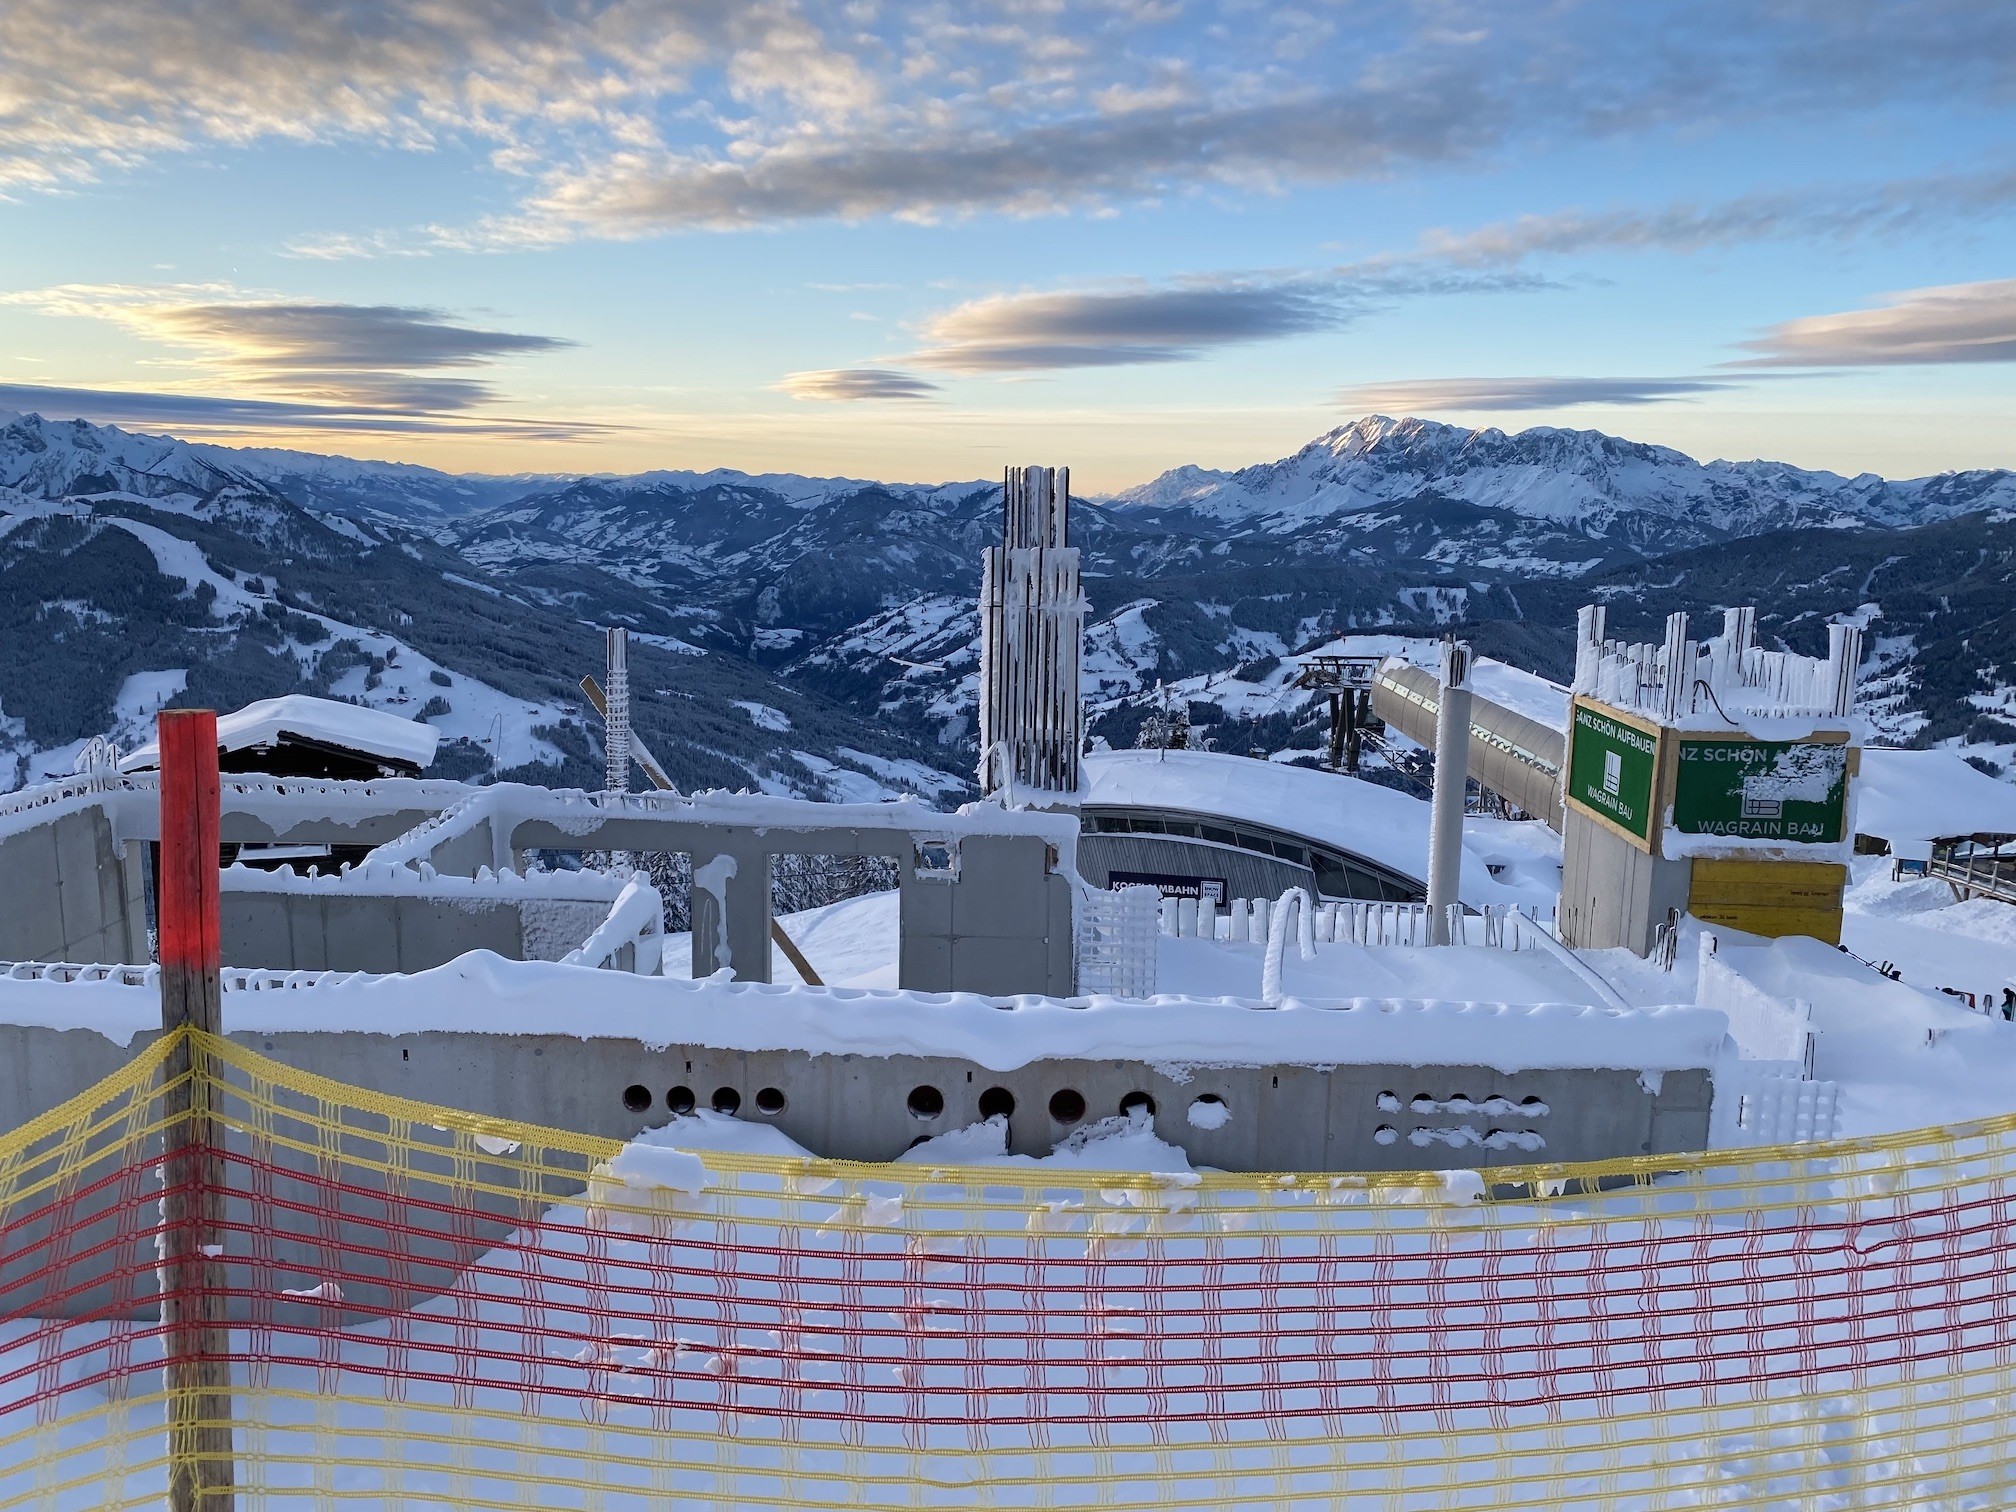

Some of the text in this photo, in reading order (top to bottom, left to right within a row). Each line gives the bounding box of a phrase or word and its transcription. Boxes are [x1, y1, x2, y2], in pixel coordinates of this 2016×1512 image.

[1592, 718, 1617, 739] SCHÖN
[1617, 728, 1656, 756] AUFBAUEN
[1703, 745, 1768, 763] SCHÖN
[1587, 784, 1633, 821] WAGRAIN BAU
[1697, 820, 1824, 837] WAGRAIN BAU
[1112, 881, 1199, 896] KOGMBAHN
